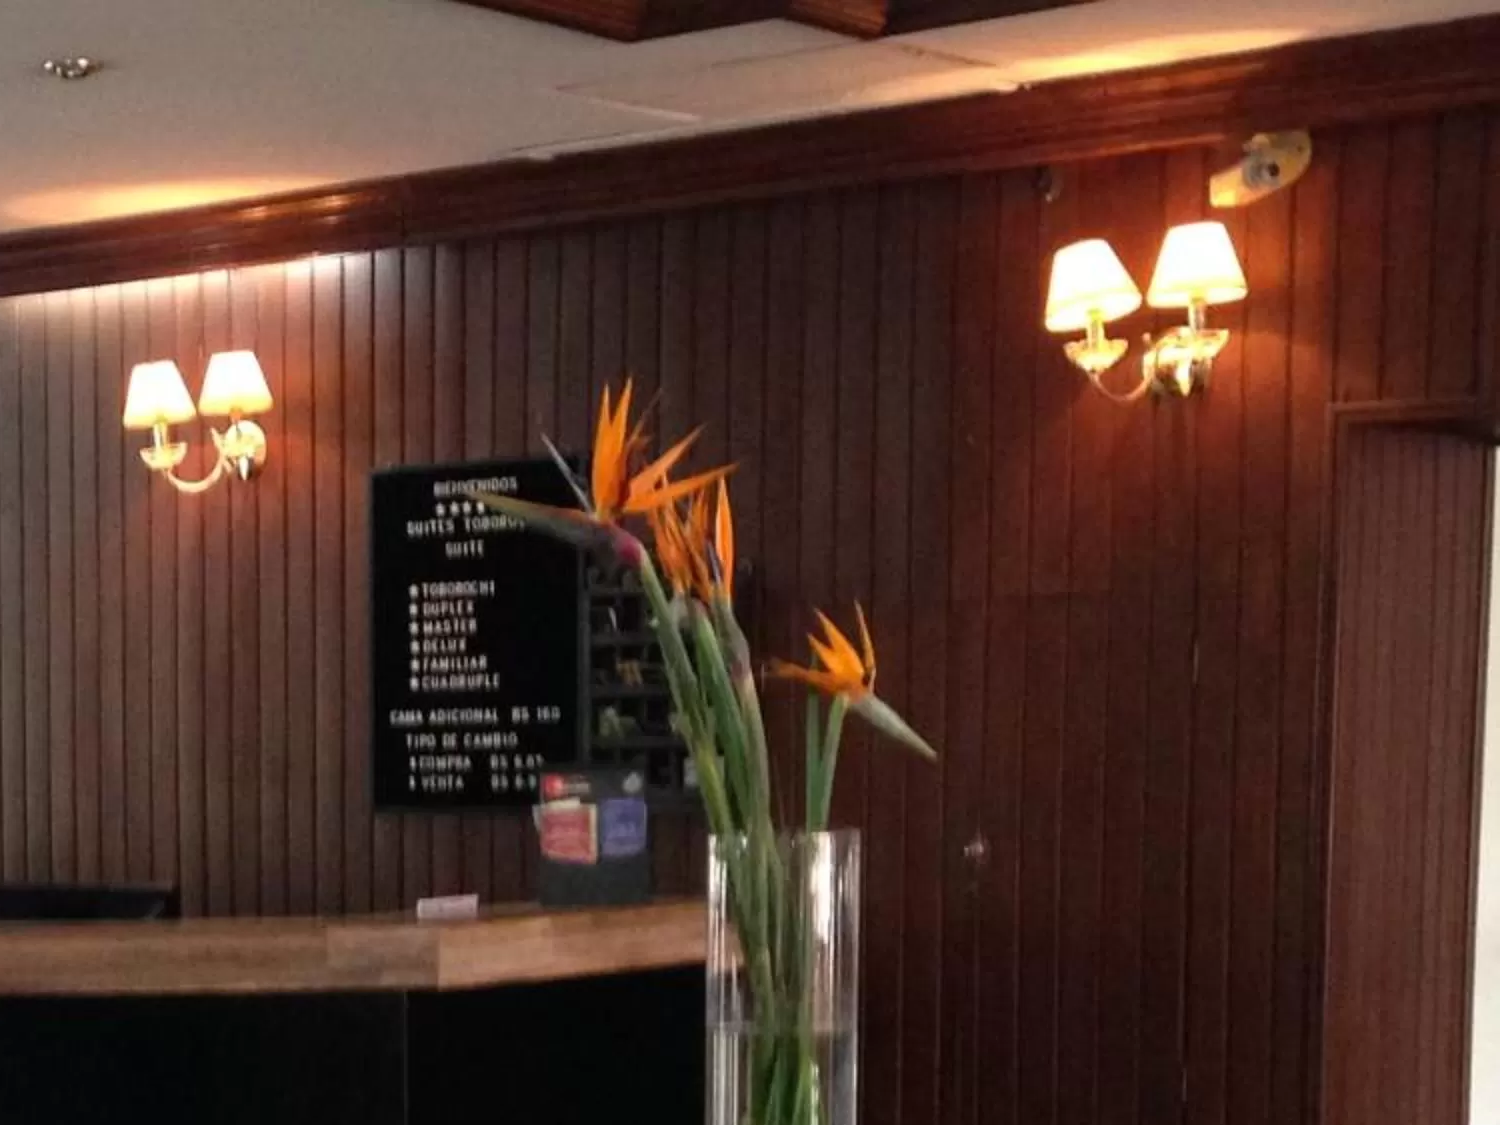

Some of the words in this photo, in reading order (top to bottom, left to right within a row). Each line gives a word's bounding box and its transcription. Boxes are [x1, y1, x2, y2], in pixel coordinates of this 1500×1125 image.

[422, 580, 495, 599] TOBOROCHI
[423, 618, 477, 636] MASTER
[422, 655, 487, 672] FAMILIAR
[421, 673, 500, 691] CUADRUPLE
[429, 708, 498, 725] ADICIONAL
[442, 732, 457, 749] DE
[464, 731, 518, 749] CAMBIO
